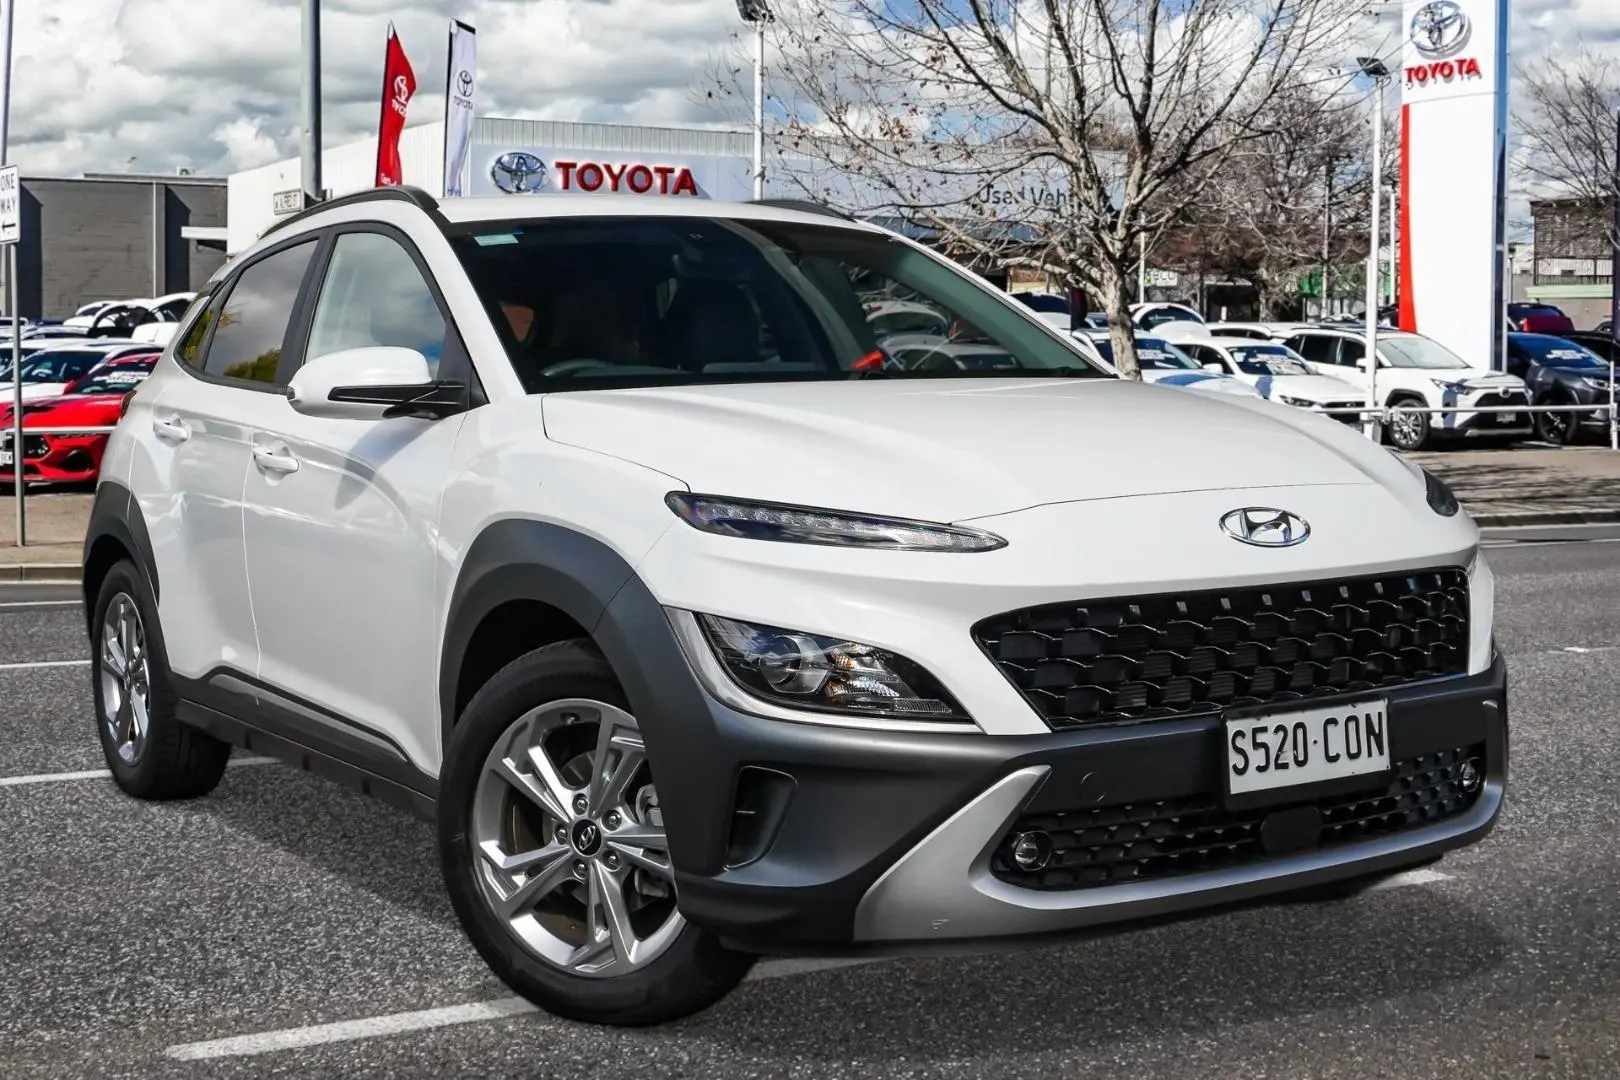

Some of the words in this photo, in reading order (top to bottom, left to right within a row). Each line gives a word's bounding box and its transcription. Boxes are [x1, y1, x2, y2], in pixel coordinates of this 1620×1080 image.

[1404, 58, 1481, 82] TOYOTA
[453, 94, 474, 111] TOYOTA
[0, 173, 16, 192] ONE
[555, 161, 698, 196] TOYOTA
